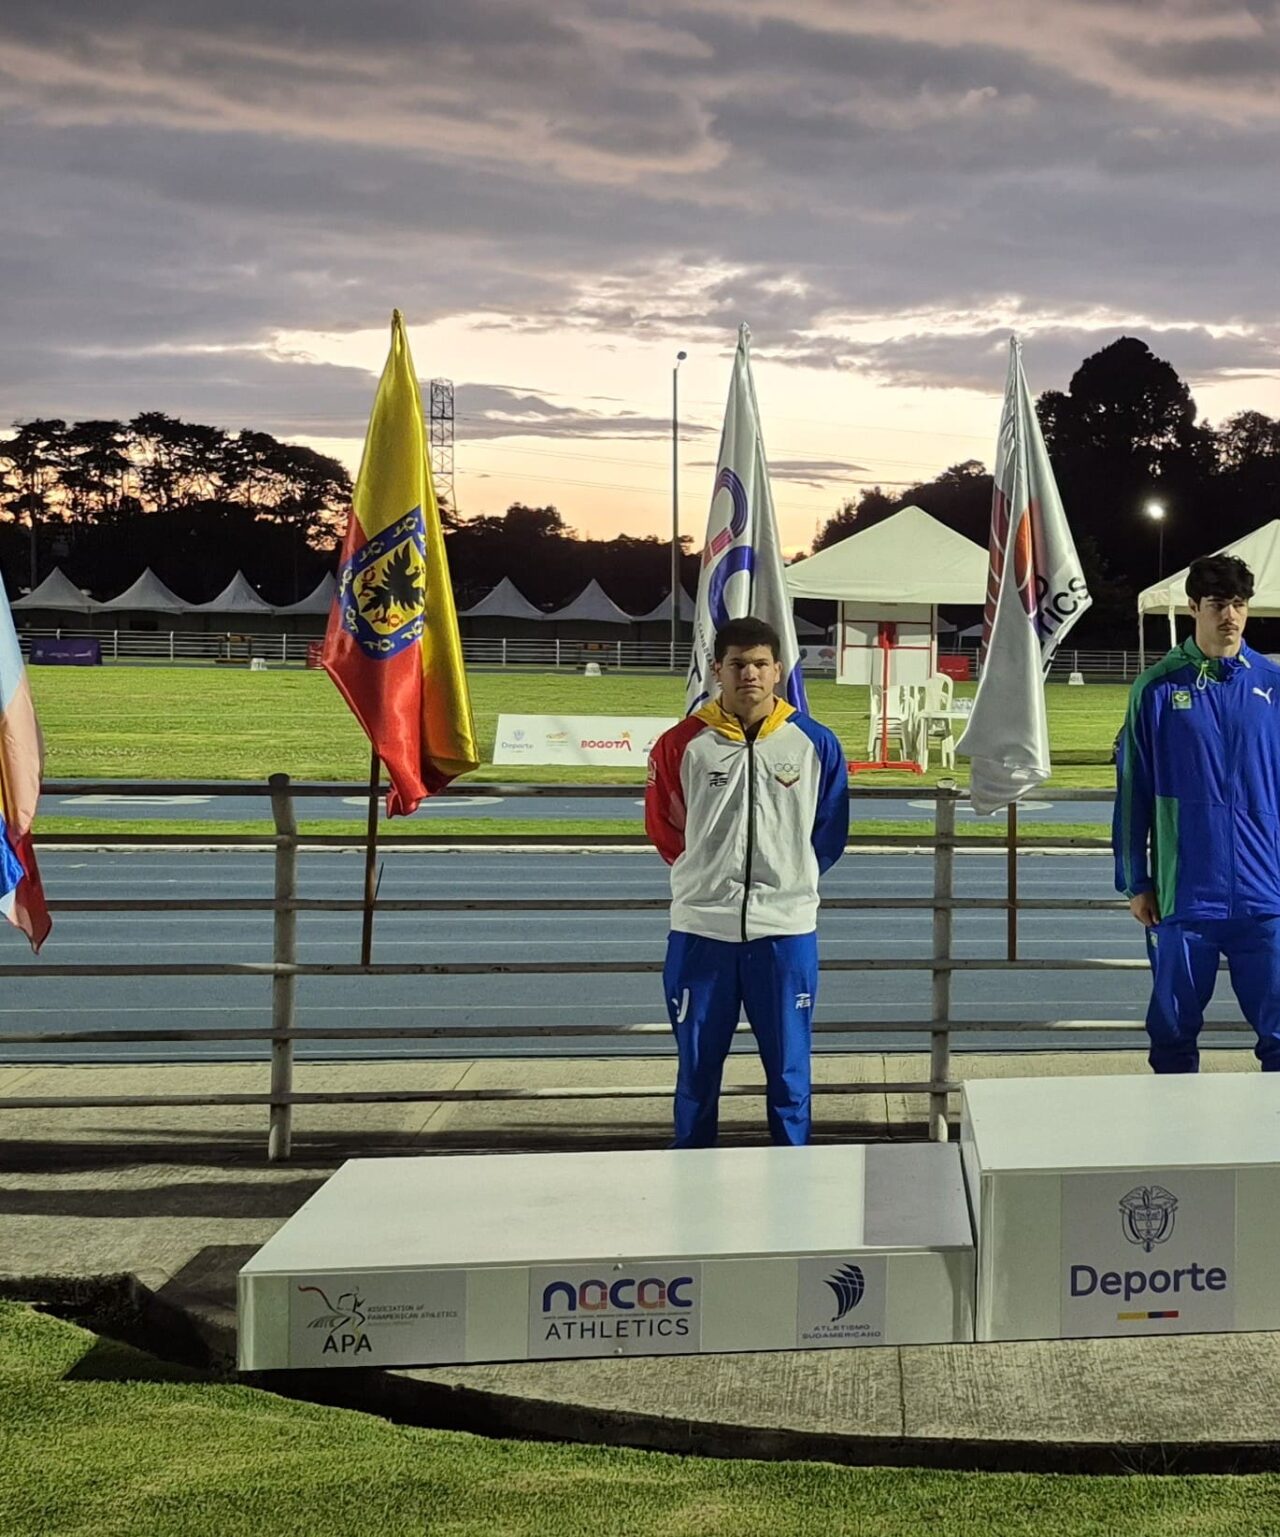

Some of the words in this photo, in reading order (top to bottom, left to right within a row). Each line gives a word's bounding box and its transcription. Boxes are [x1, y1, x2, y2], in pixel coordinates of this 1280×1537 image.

[1070, 1262, 1227, 1301] Deporte
[542, 1277, 693, 1312] nacac
[545, 1318, 690, 1341] ATHLETICS
[802, 1331, 881, 1339] SUDAMERICANO
[813, 1323, 871, 1332] ATLETISMO
[322, 1333, 372, 1355] APA
